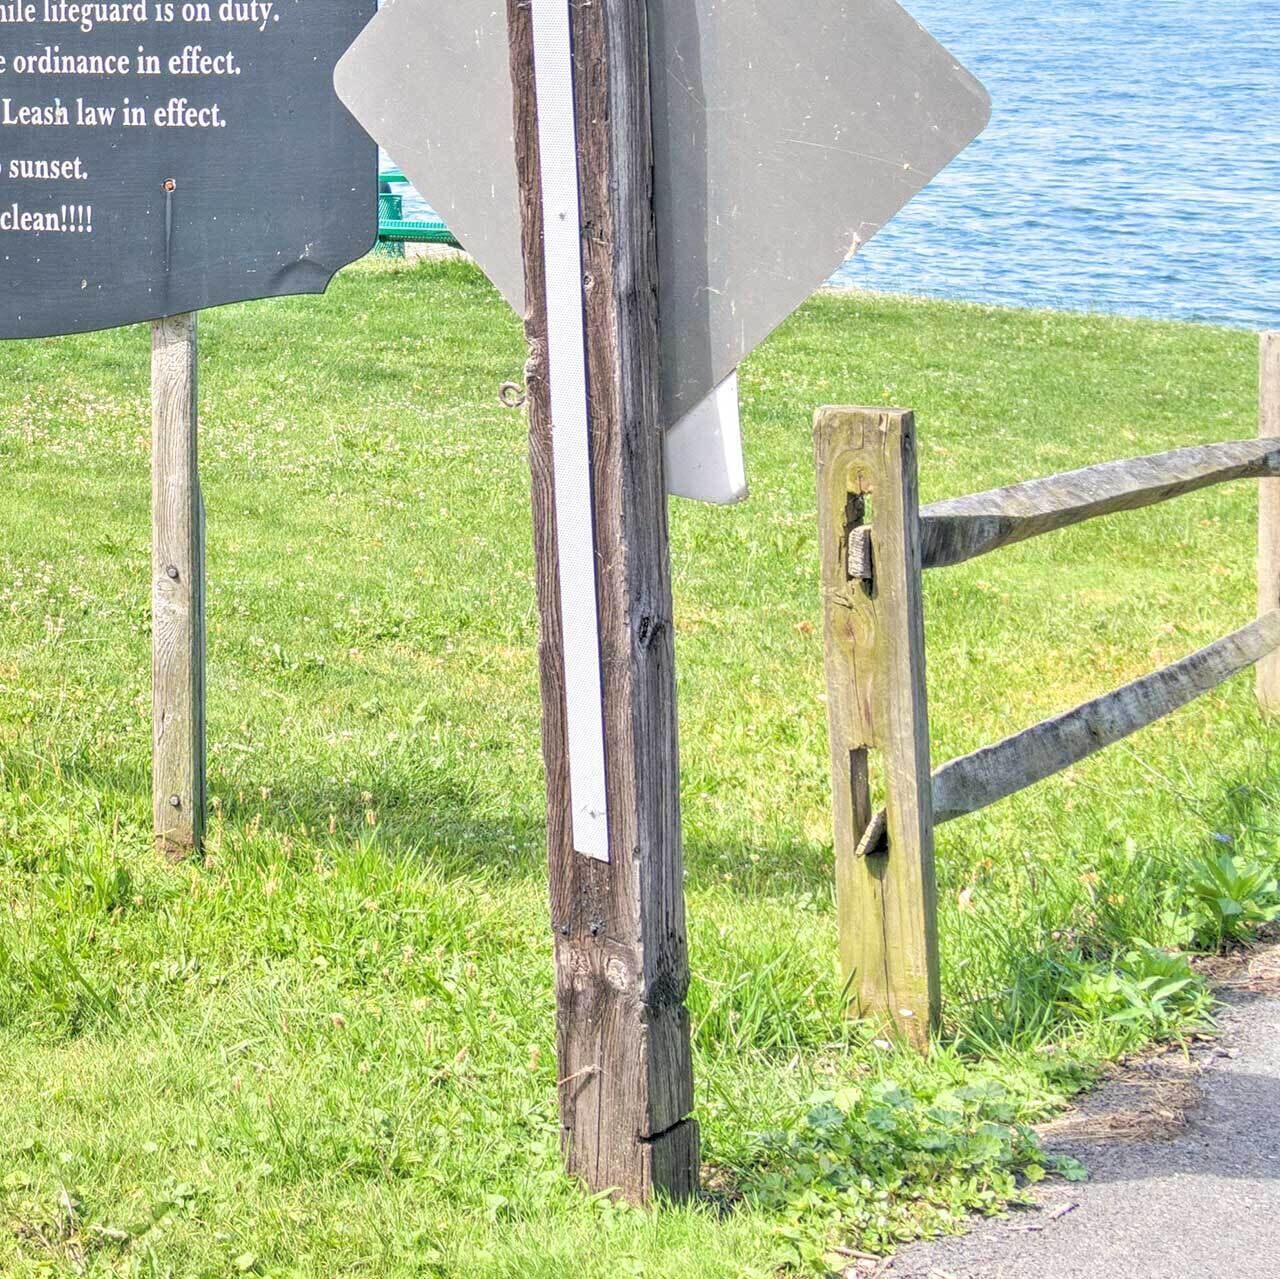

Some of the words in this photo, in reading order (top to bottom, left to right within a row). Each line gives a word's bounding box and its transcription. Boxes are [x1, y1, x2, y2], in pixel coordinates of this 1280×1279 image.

[182, 1, 211, 22] on
[13, 46, 130, 74] ordinance
[137, 45, 161, 74] in
[168, 46, 241, 75] effect.
[2, 97, 69, 126] Leash
[76, 97, 115, 125] law
[122, 98, 146, 126] in
[154, 98, 226, 127] effect.
[9, 156, 88, 180] sunset.
[0, 203, 92, 233] clean!!!!
